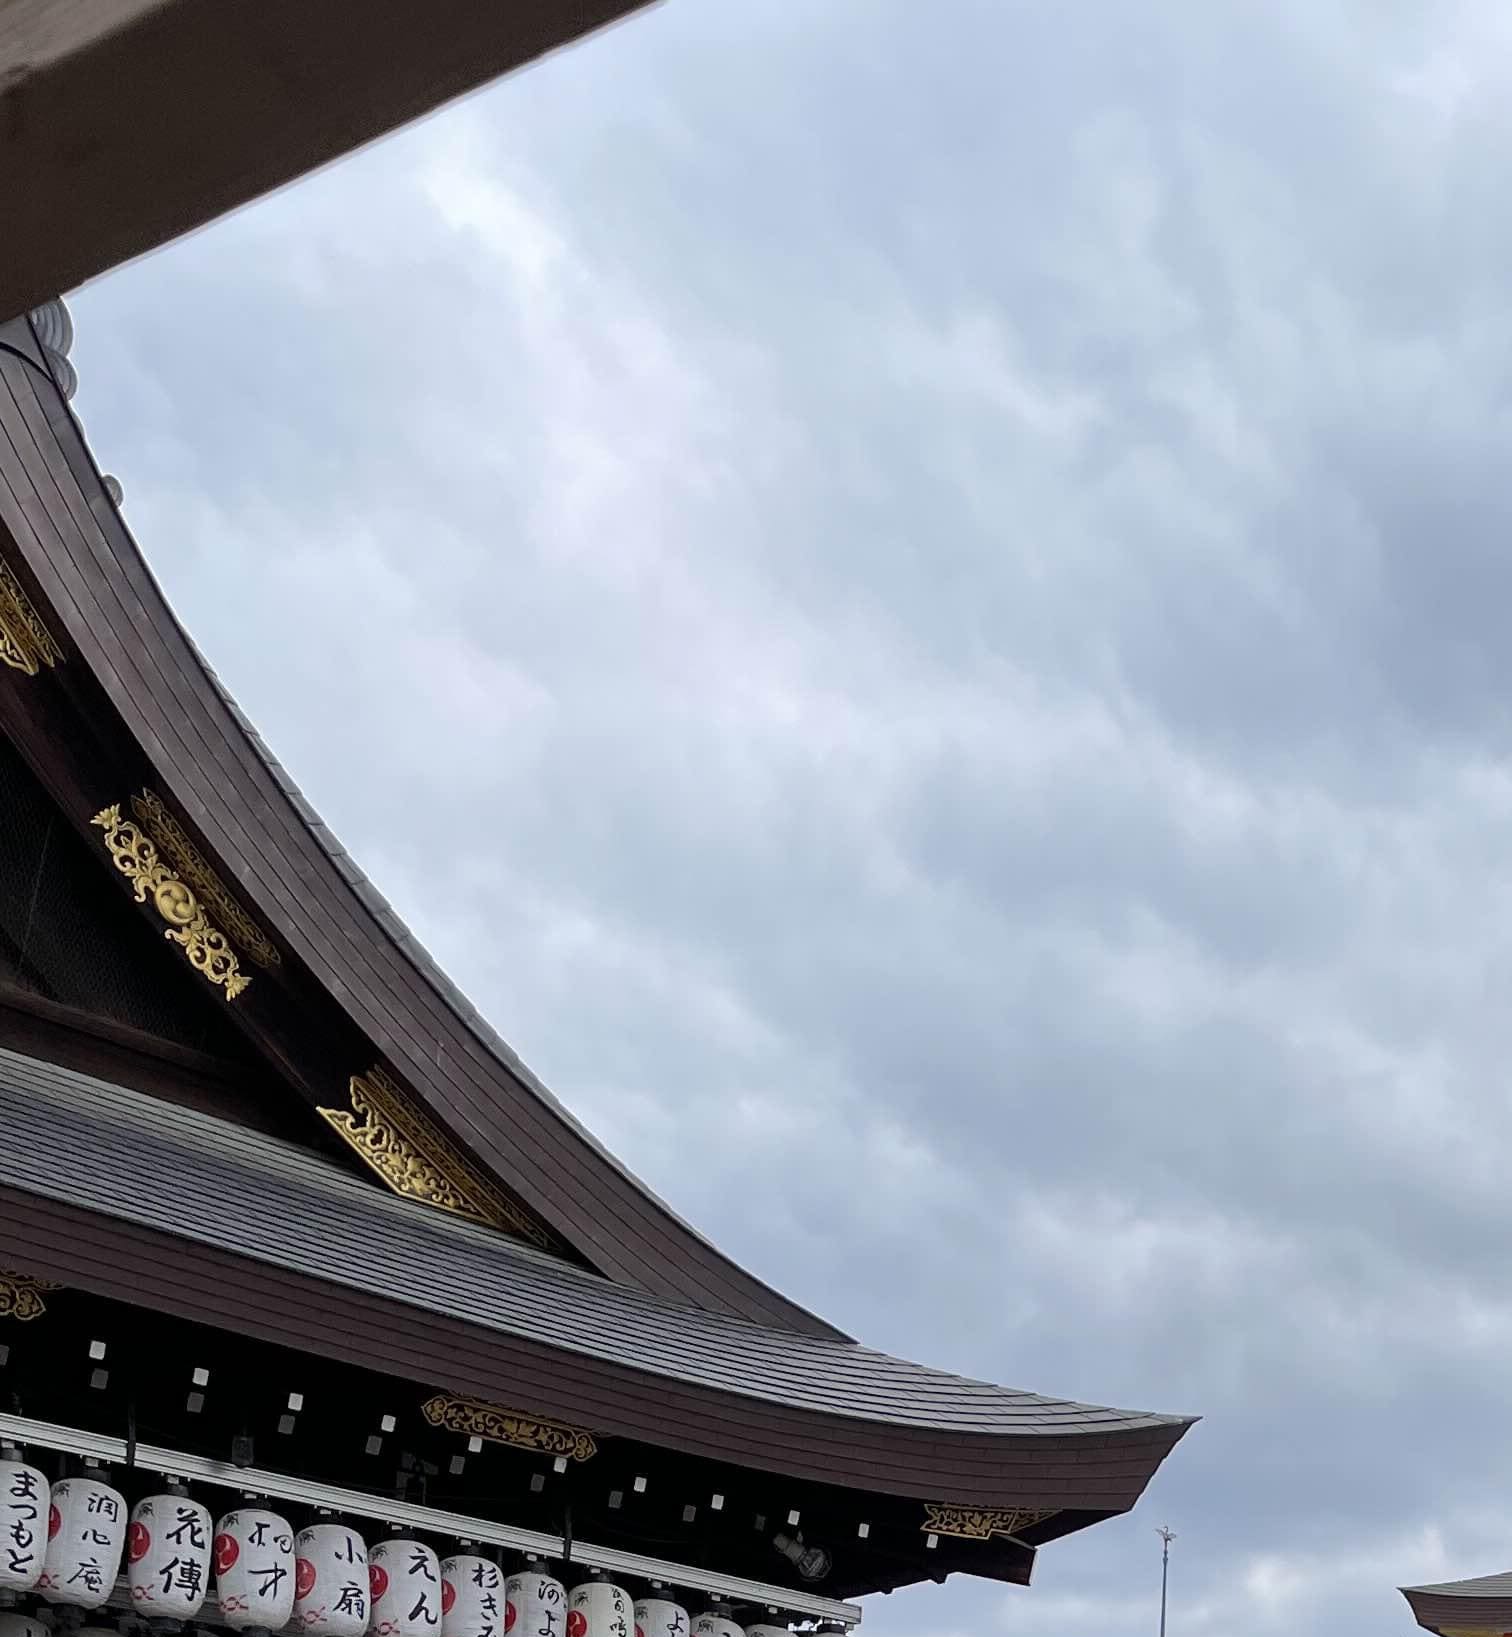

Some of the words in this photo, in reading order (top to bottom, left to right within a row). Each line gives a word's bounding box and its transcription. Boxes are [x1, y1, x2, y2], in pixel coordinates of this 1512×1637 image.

[6, 1470, 38, 1574] まつもと
[332, 1536, 364, 1620] 小扇
[408, 1547, 438, 1625] えん
